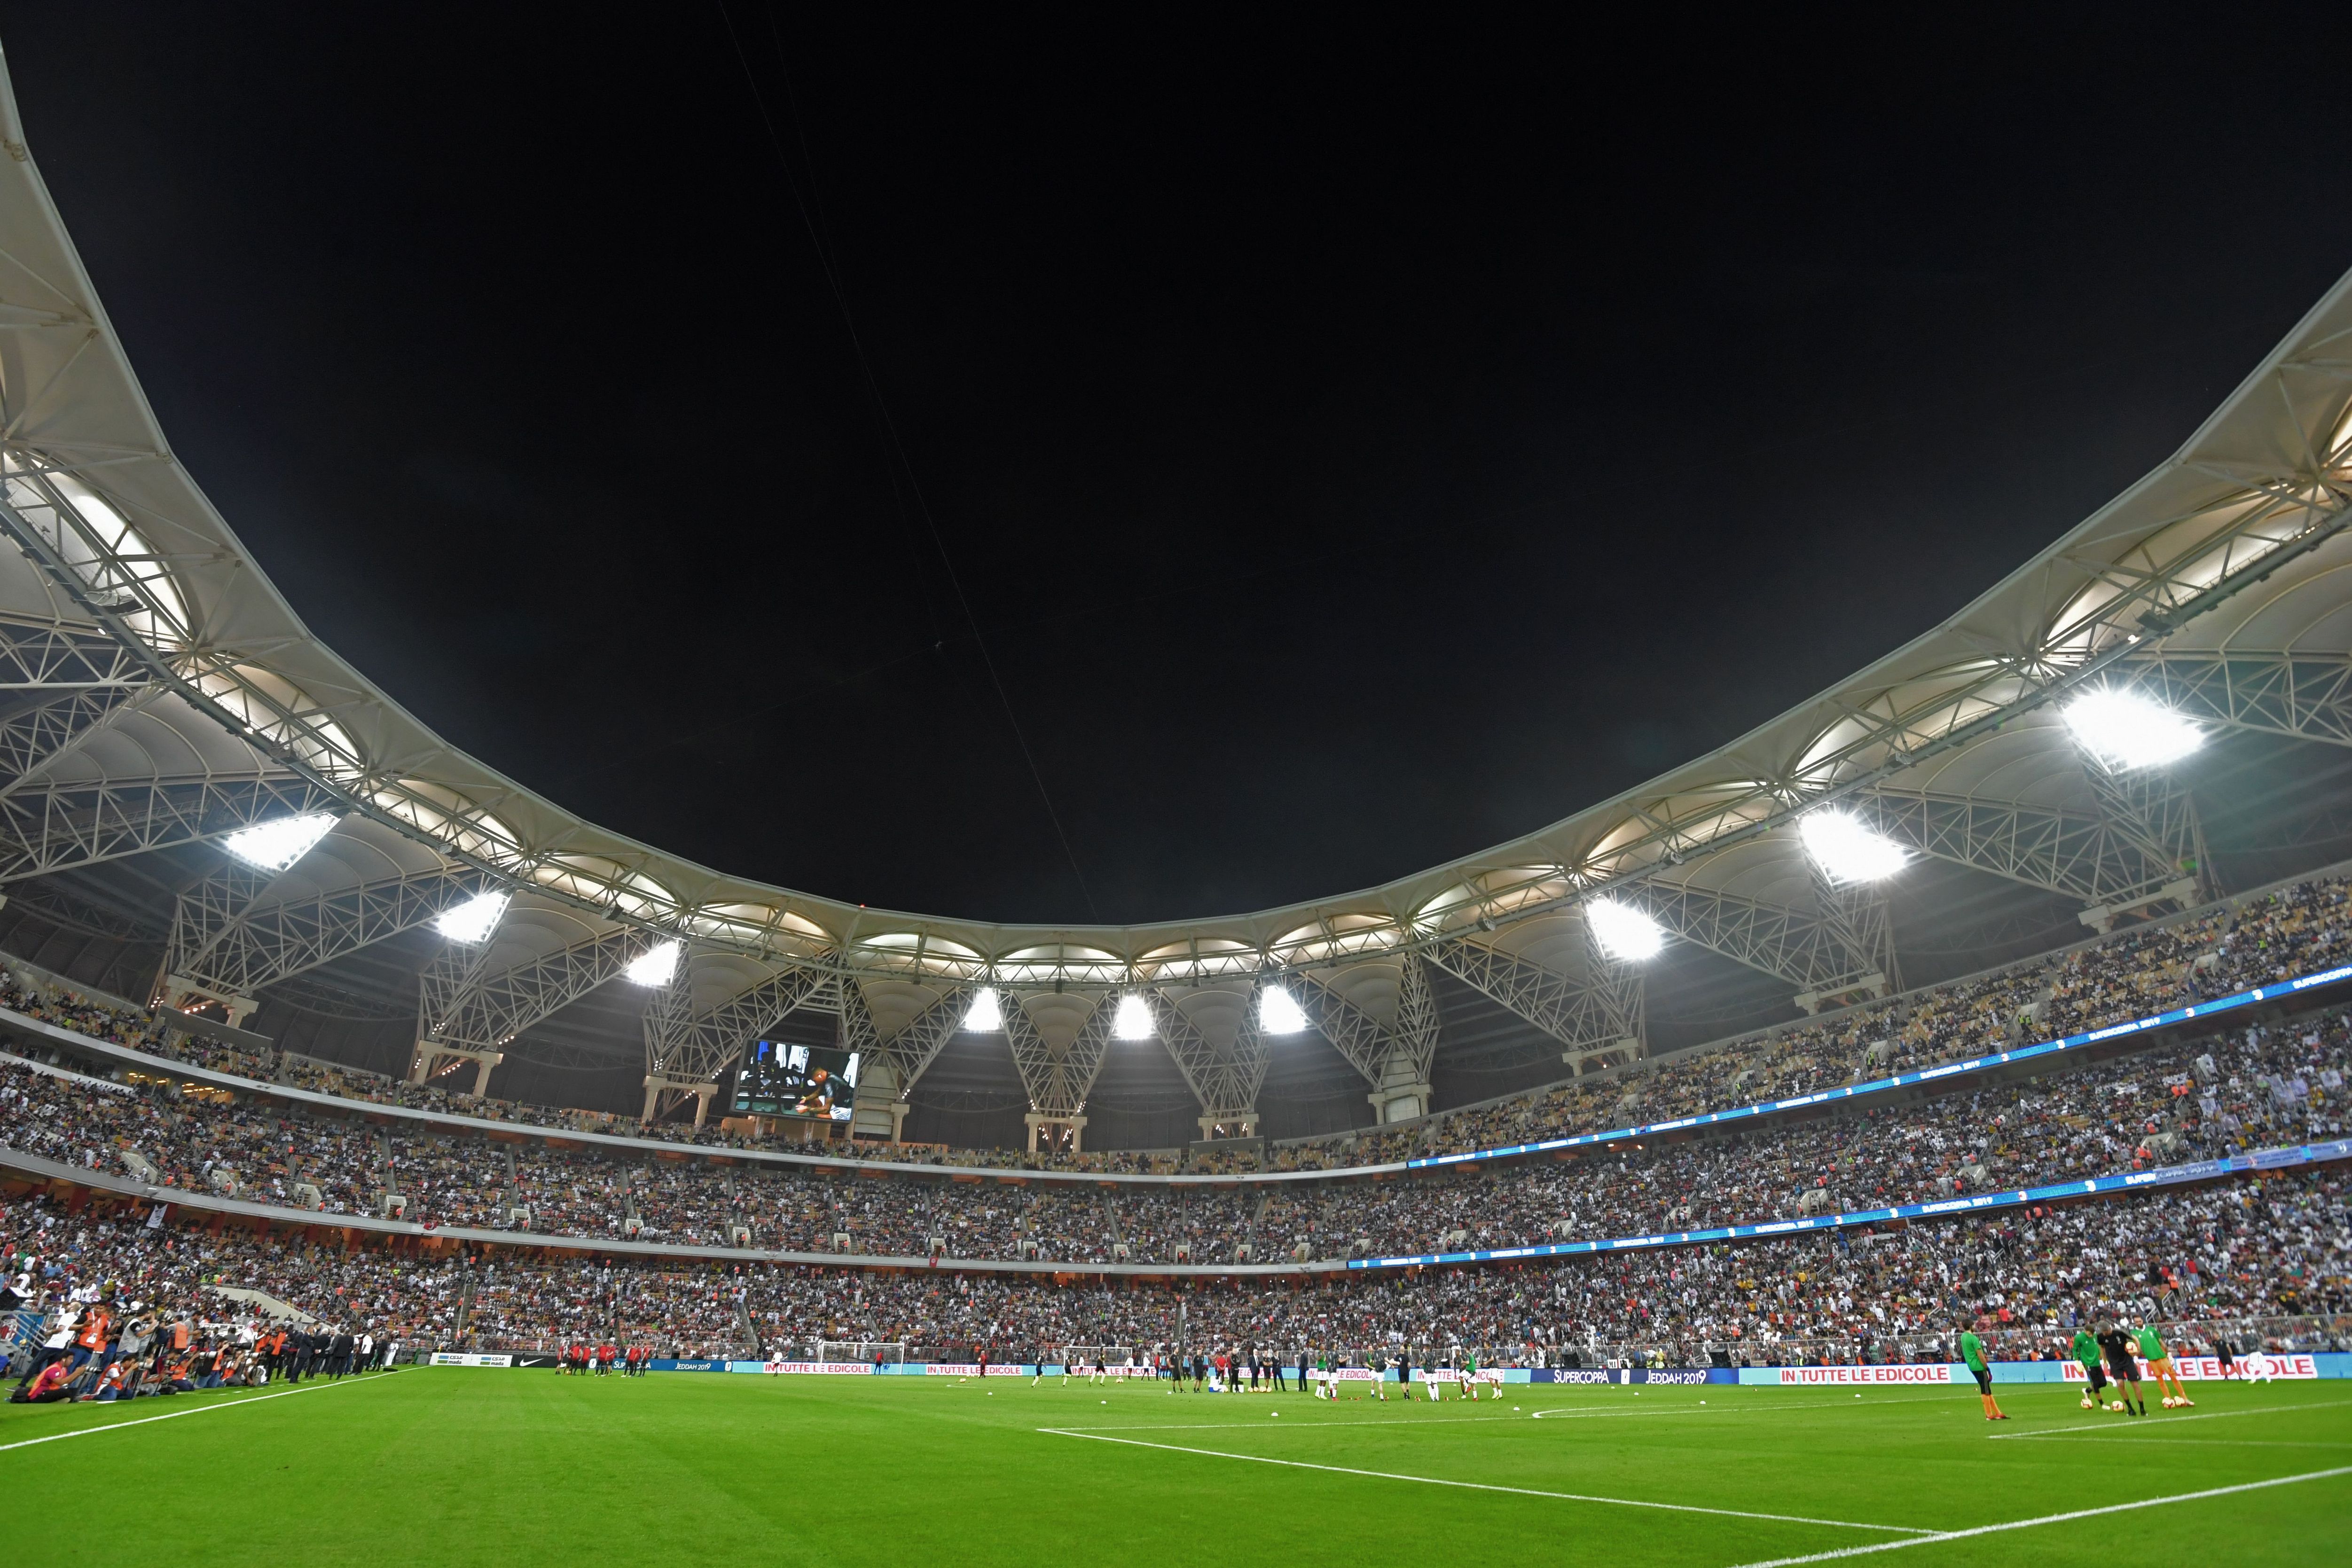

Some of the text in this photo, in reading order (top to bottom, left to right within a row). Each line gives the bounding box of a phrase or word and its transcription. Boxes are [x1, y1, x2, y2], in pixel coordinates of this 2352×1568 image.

[828, 1364, 870, 1373] EDICOLE
[1781, 1367, 1948, 1382] IN TUTTE LE EDICOLE
[1553, 1369, 1610, 1384] SUPERCOPPA
[1646, 1369, 1707, 1384] JEDDAH 2019
